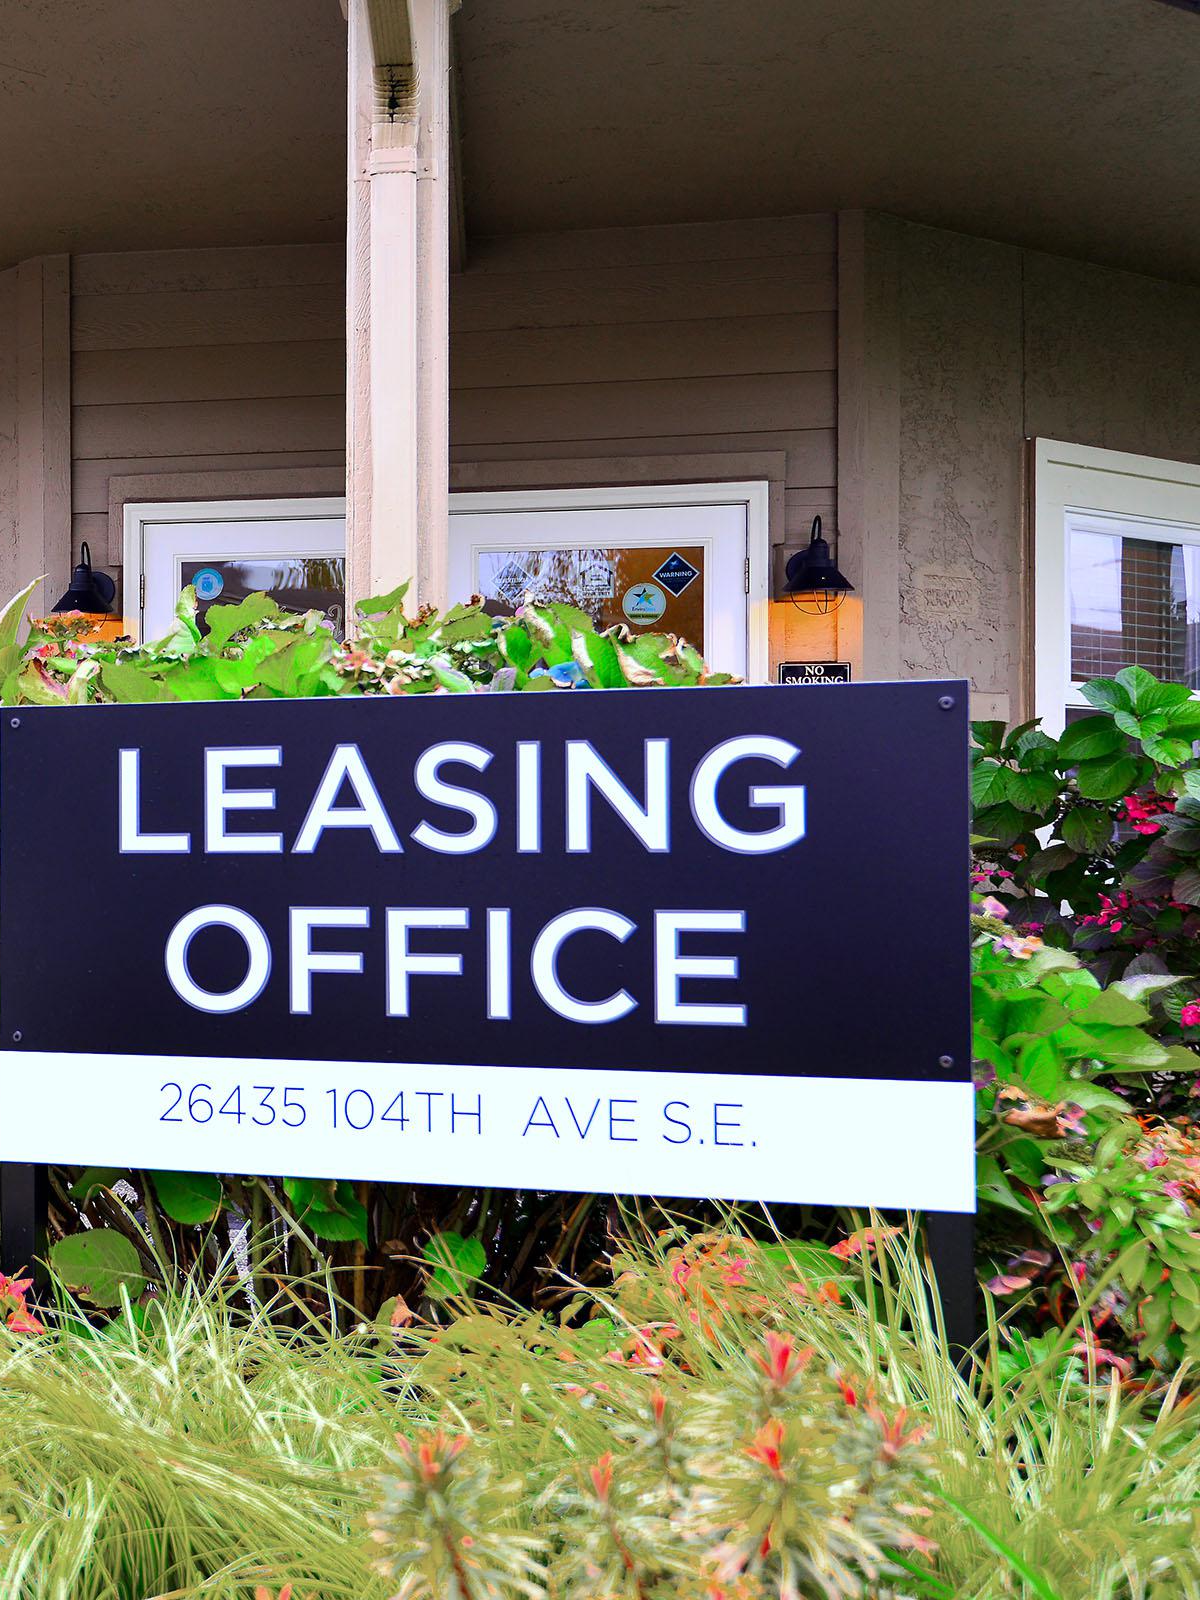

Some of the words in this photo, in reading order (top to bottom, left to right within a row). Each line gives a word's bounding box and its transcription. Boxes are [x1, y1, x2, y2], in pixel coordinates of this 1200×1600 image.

[659, 570, 693, 578] WARNING
[785, 675, 844, 686] SMOKING
[804, 665, 825, 676] NO
[118, 734, 806, 856] LEASING
[164, 903, 748, 1027] OFFICE
[159, 1082, 307, 1128] 26435
[325, 1087, 482, 1135] 104TH
[522, 1095, 638, 1143] AVE
[662, 1101, 757, 1148] S.E.
